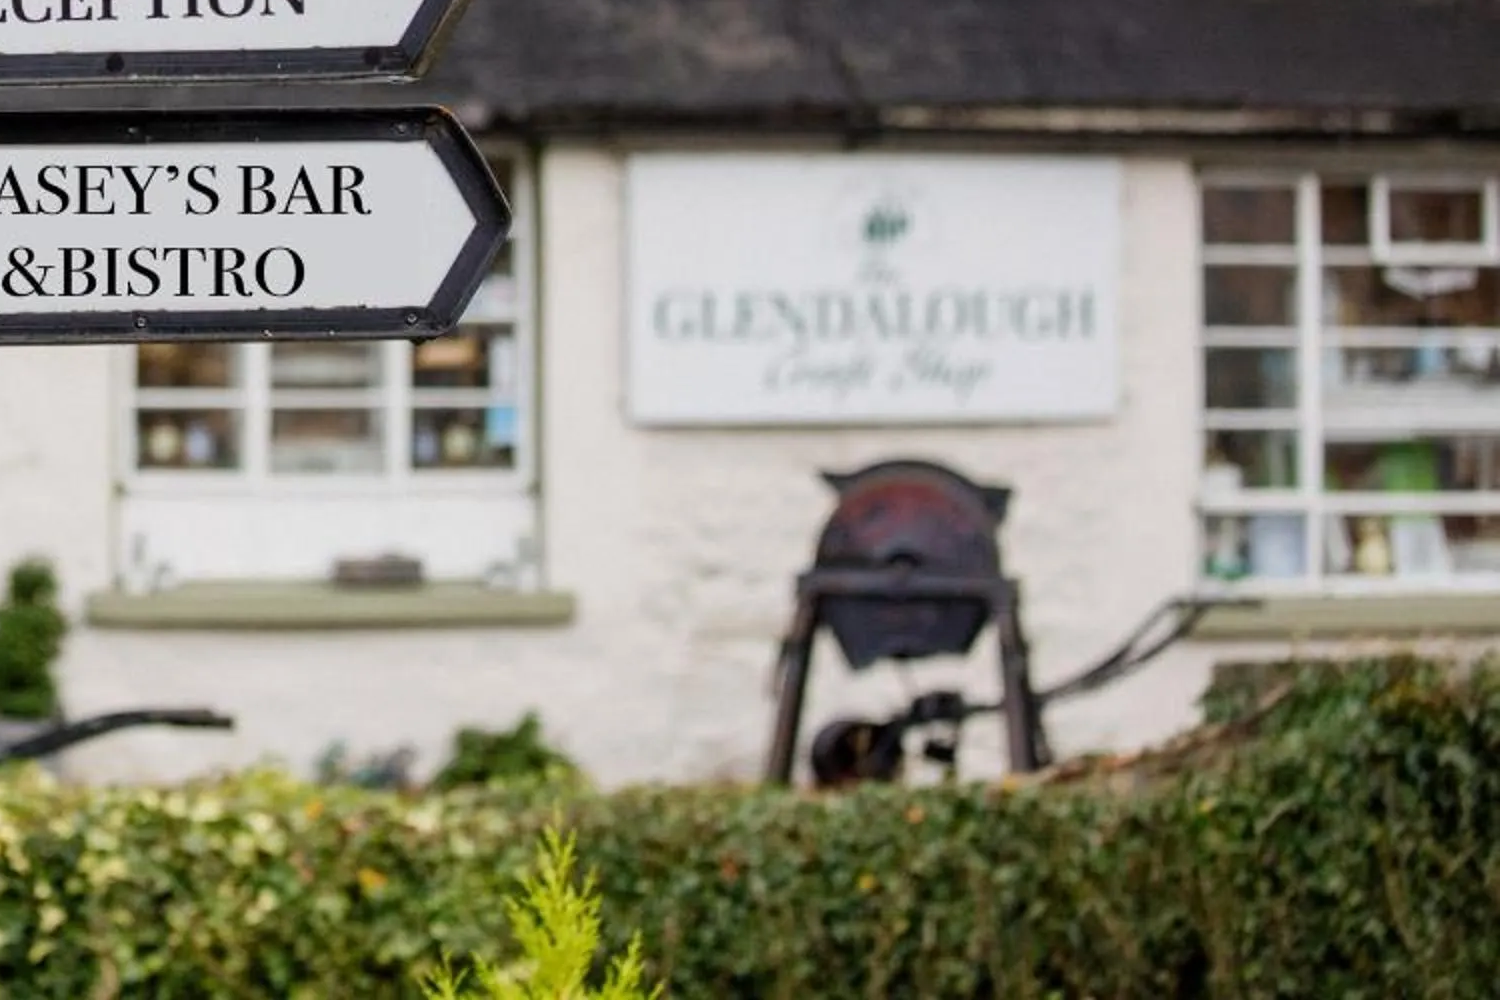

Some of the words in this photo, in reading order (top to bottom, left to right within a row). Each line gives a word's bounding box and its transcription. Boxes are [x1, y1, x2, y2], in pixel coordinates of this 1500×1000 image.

[237, 165, 373, 215] BAR
[1, 247, 305, 298] &BISTRO
[652, 288, 1097, 341] GLENDALOUGH
